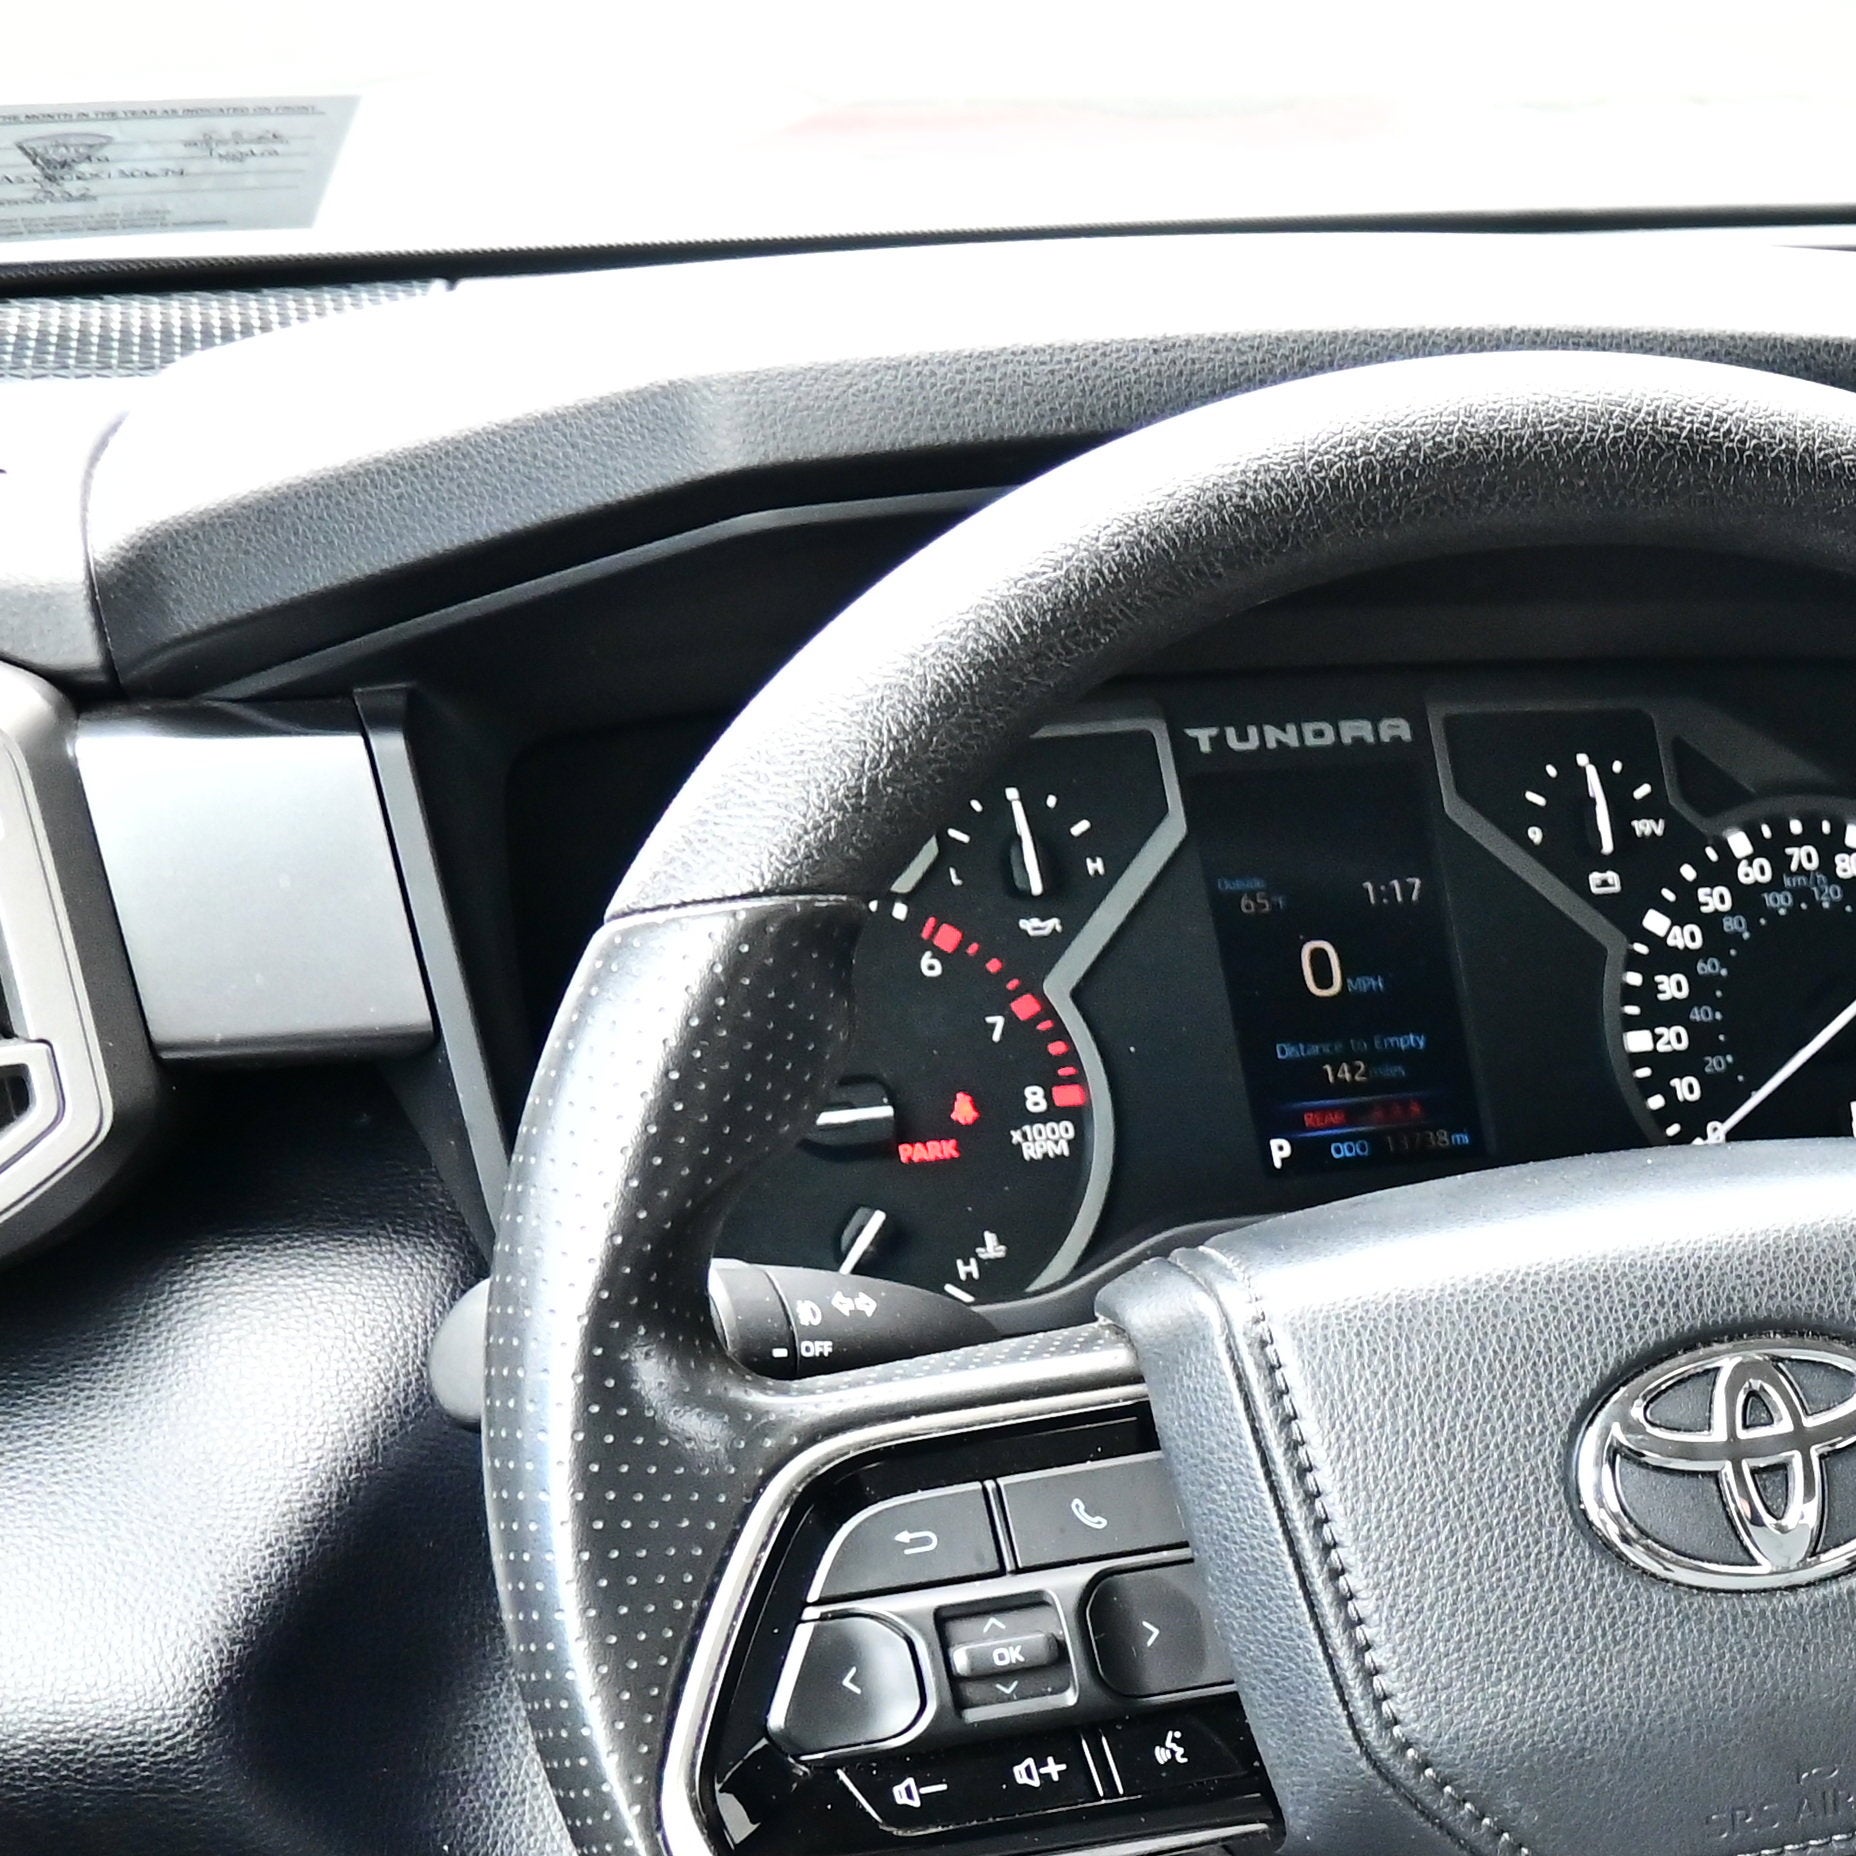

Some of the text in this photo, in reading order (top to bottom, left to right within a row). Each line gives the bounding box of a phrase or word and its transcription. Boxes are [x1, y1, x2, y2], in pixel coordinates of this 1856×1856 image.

[24, 112, 73, 121] MONTH
[1184, 717, 1412, 753] TUNDRA
[1527, 826, 1543, 845] 9
[1631, 818, 1665, 837] 19V
[1086, 856, 1105, 876] H
[1737, 857, 1772, 885] 60
[1784, 845, 1819, 872] 70
[949, 867, 963, 886] L
[1783, 871, 1827, 888] km/h
[1363, 877, 1421, 905] 1:17
[1697, 886, 1732, 914] 50
[1762, 891, 1793, 909] 100
[1811, 884, 1843, 901] 120
[1666, 923, 1703, 950] 40
[1722, 915, 1746, 933] 80
[920, 951, 942, 978] 6
[1301, 938, 1385, 997] 0 MPH
[1696, 957, 1720, 975] 60
[1654, 973, 1689, 1001] 30
[1689, 1005, 1712, 1022] 40
[985, 1015, 1005, 1042] 7
[1654, 1026, 1689, 1053] 20
[1275, 1032, 1427, 1060] Distance to Empty
[1322, 1060, 1368, 1084] 142
[1703, 1056, 1726, 1073] 20
[1024, 1085, 1047, 1113] 8
[1669, 1076, 1701, 1102] 10
[1010, 1120, 1075, 1146] x1000
[898, 1139, 960, 1164] PARK
[1021, 1140, 1070, 1161] RPM
[1269, 1138, 1292, 1169] P
[956, 1257, 980, 1282] H
[800, 1340, 833, 1358] OFF
[993, 1645, 1025, 1666] OK
